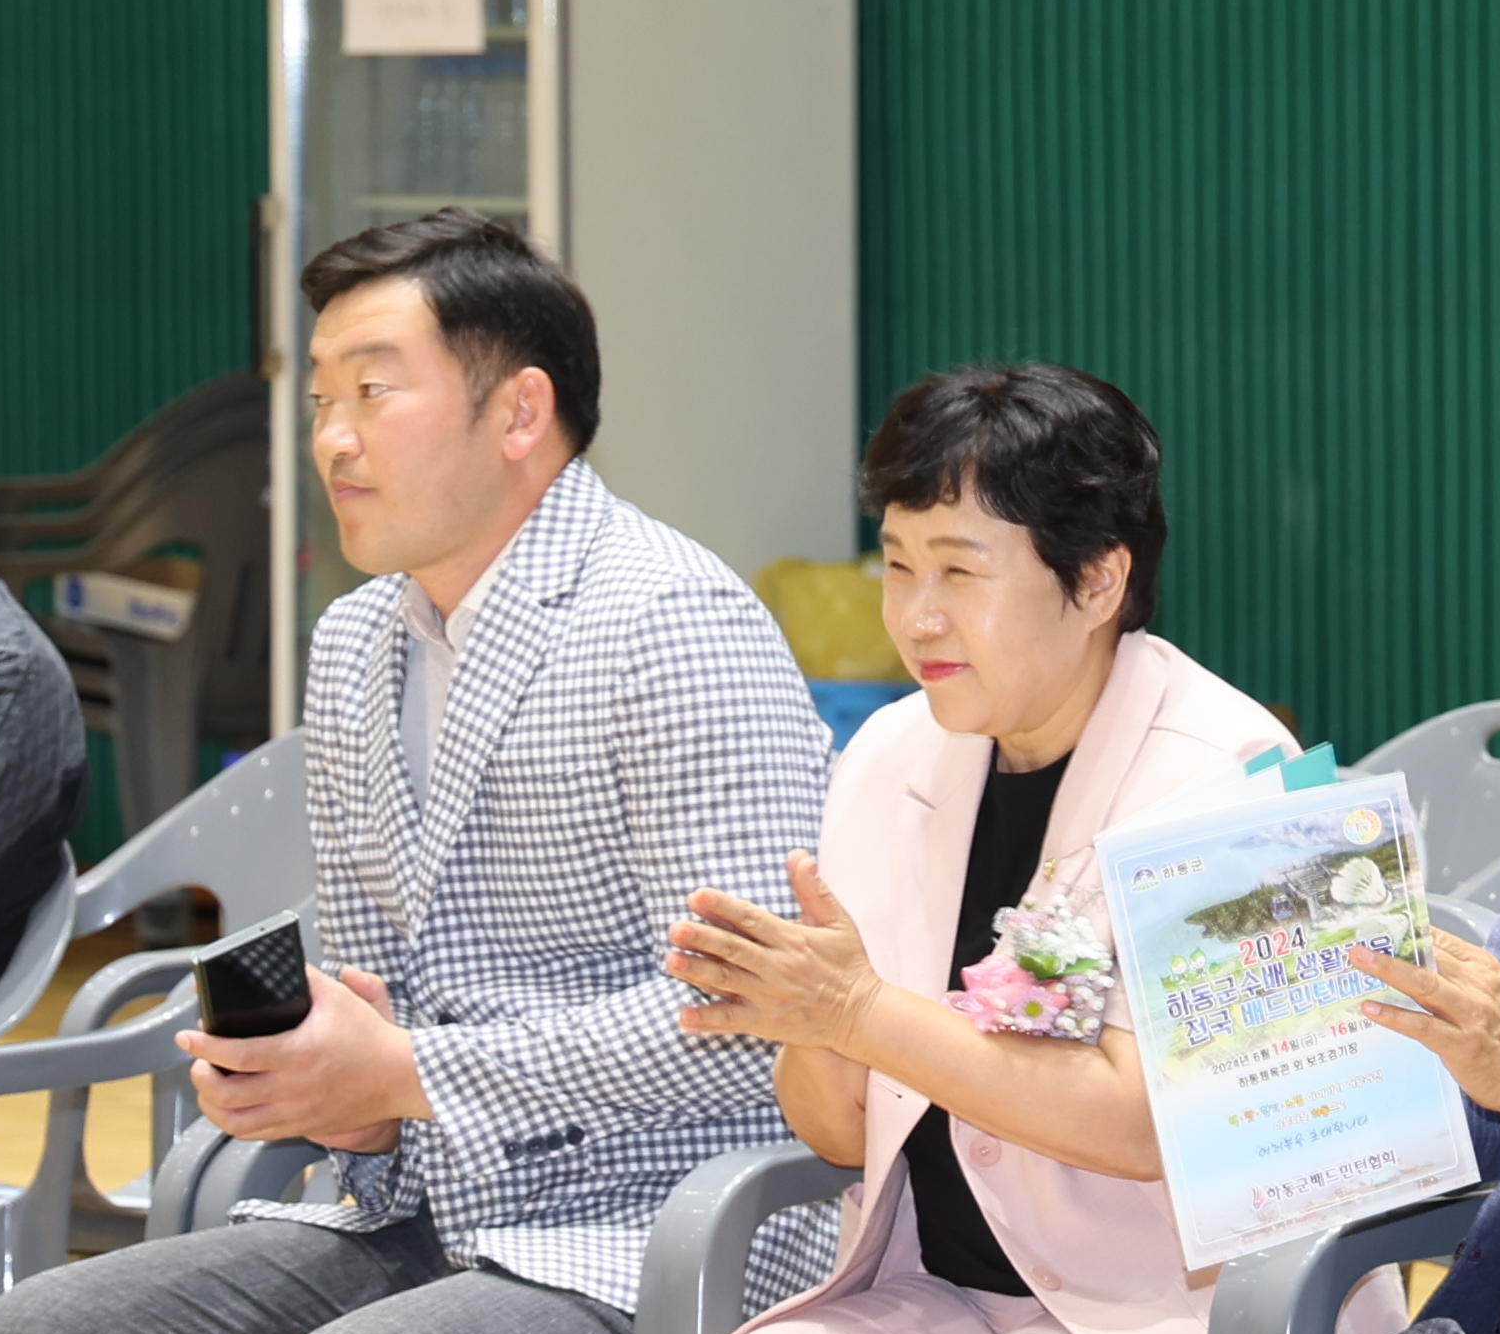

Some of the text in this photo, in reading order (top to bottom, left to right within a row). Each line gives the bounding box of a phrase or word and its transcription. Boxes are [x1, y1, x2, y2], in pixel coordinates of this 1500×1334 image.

[1162, 859, 1204, 880] 하동군
[1238, 924, 1307, 966] 2024
[1165, 934, 1395, 1020] 하동군수배 생활육
[1184, 1009, 1234, 1047] 전국
